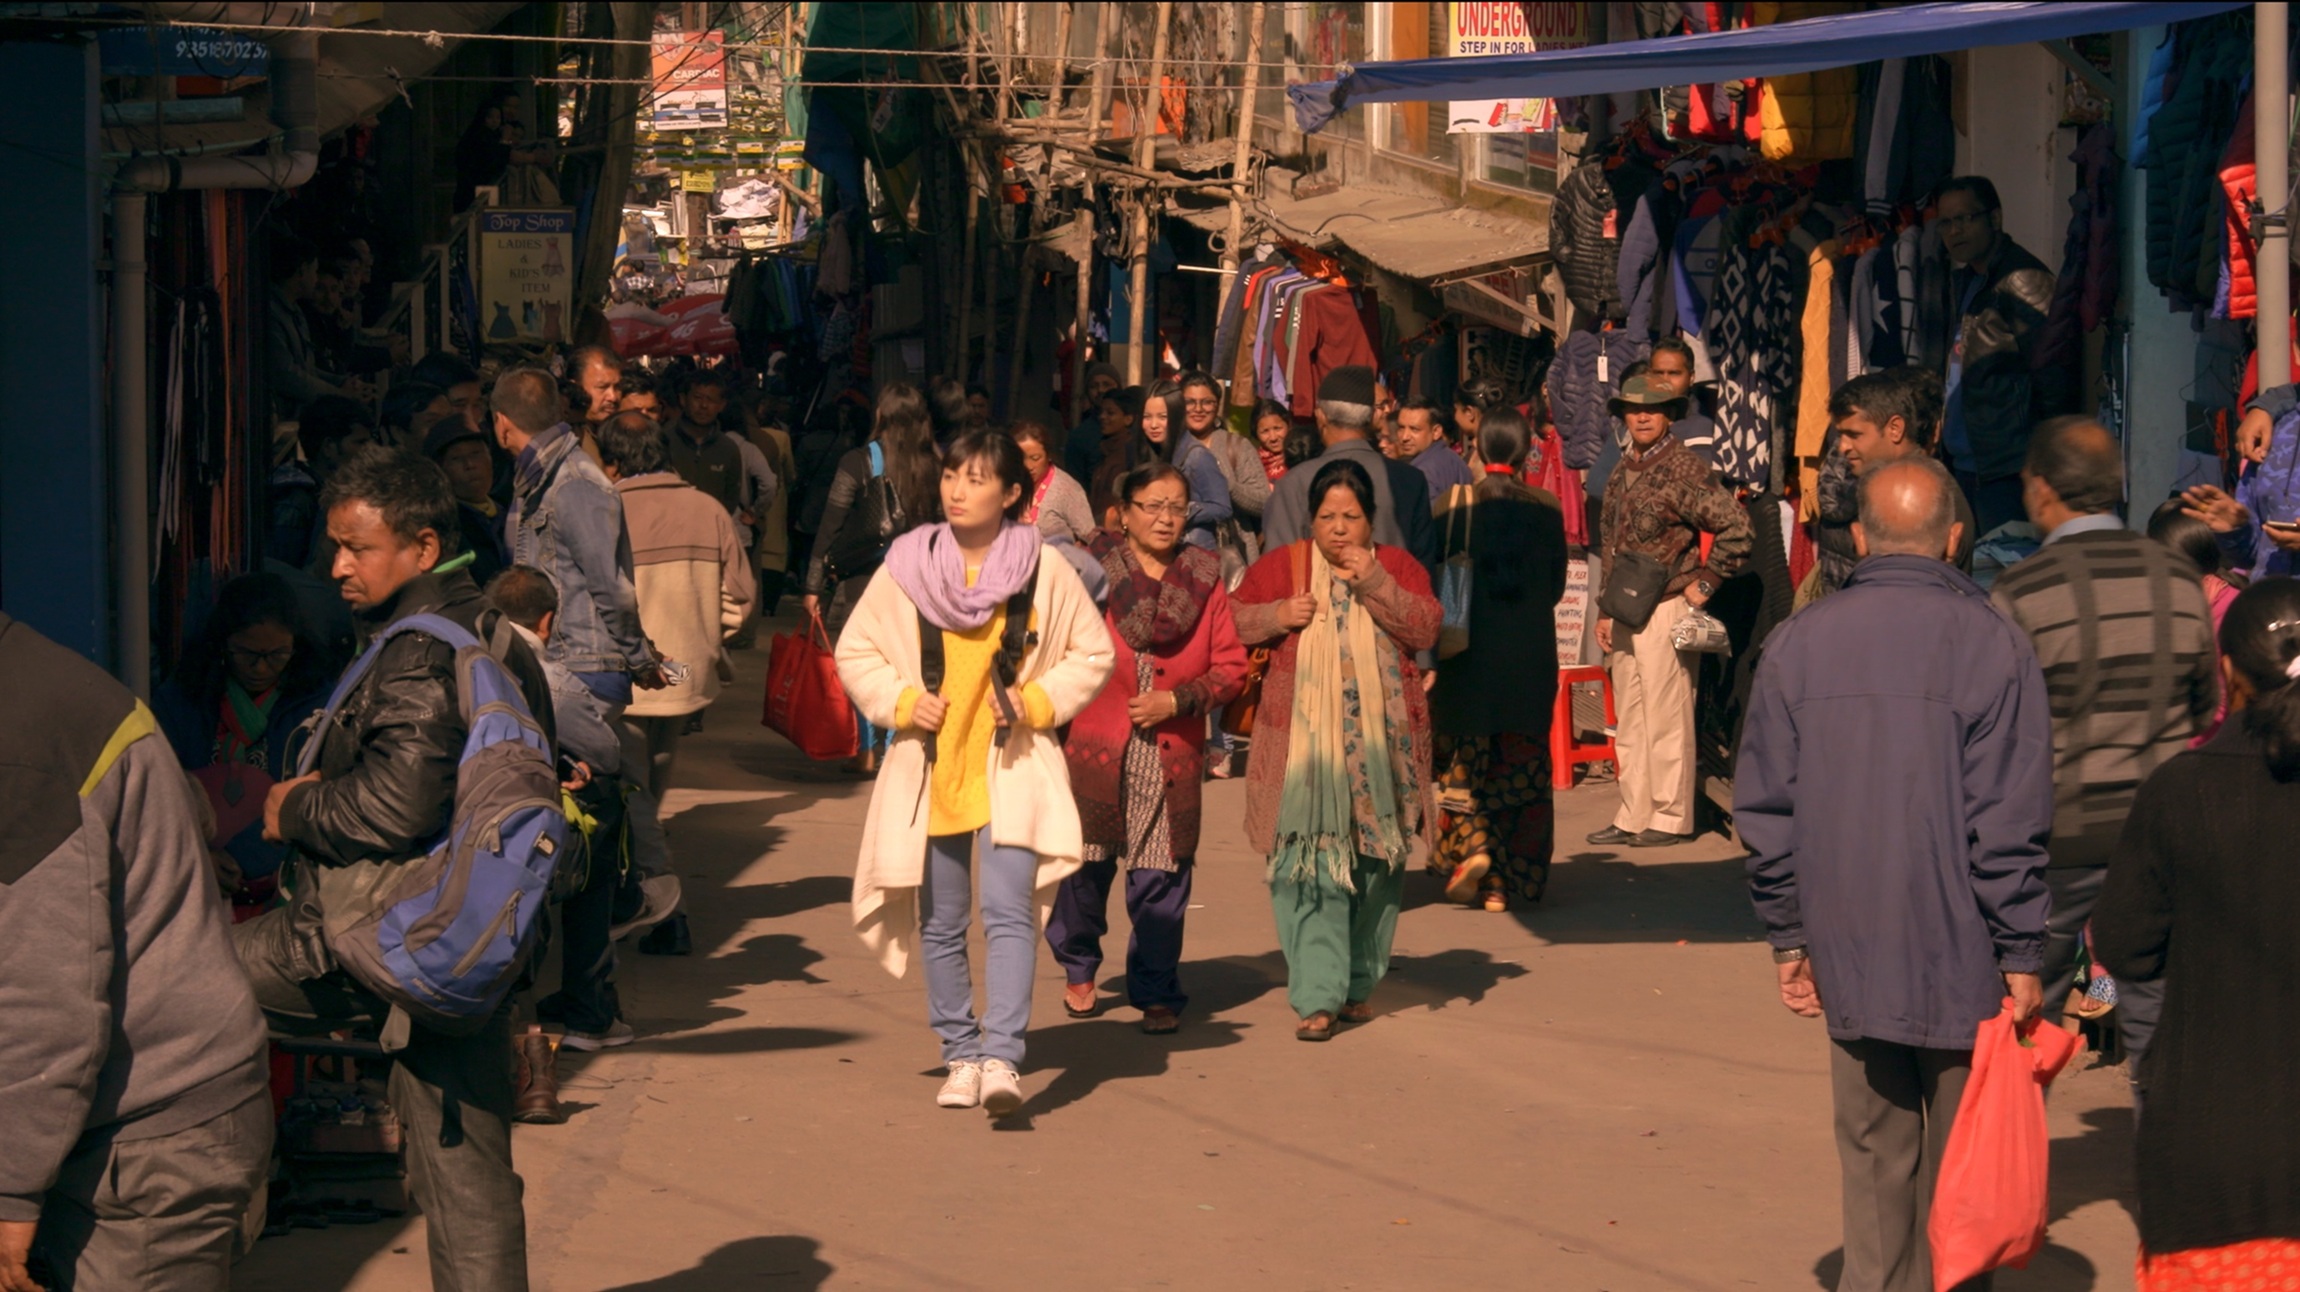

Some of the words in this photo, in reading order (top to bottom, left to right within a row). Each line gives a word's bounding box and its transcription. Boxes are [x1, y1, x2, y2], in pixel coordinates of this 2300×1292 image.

[1457, 2, 1577, 37] UNDERGROUND
[1460, 41, 1486, 53] STEP
[1490, 42, 1501, 53] IN
[1505, 42, 1525, 54] FOR
[490, 214, 520, 231] Top
[525, 214, 564, 231] Shop
[498, 239, 542, 249] LADIES
[520, 254, 528, 264] &
[510, 268, 540, 279] KID'S
[521, 283, 550, 293] ITEM
